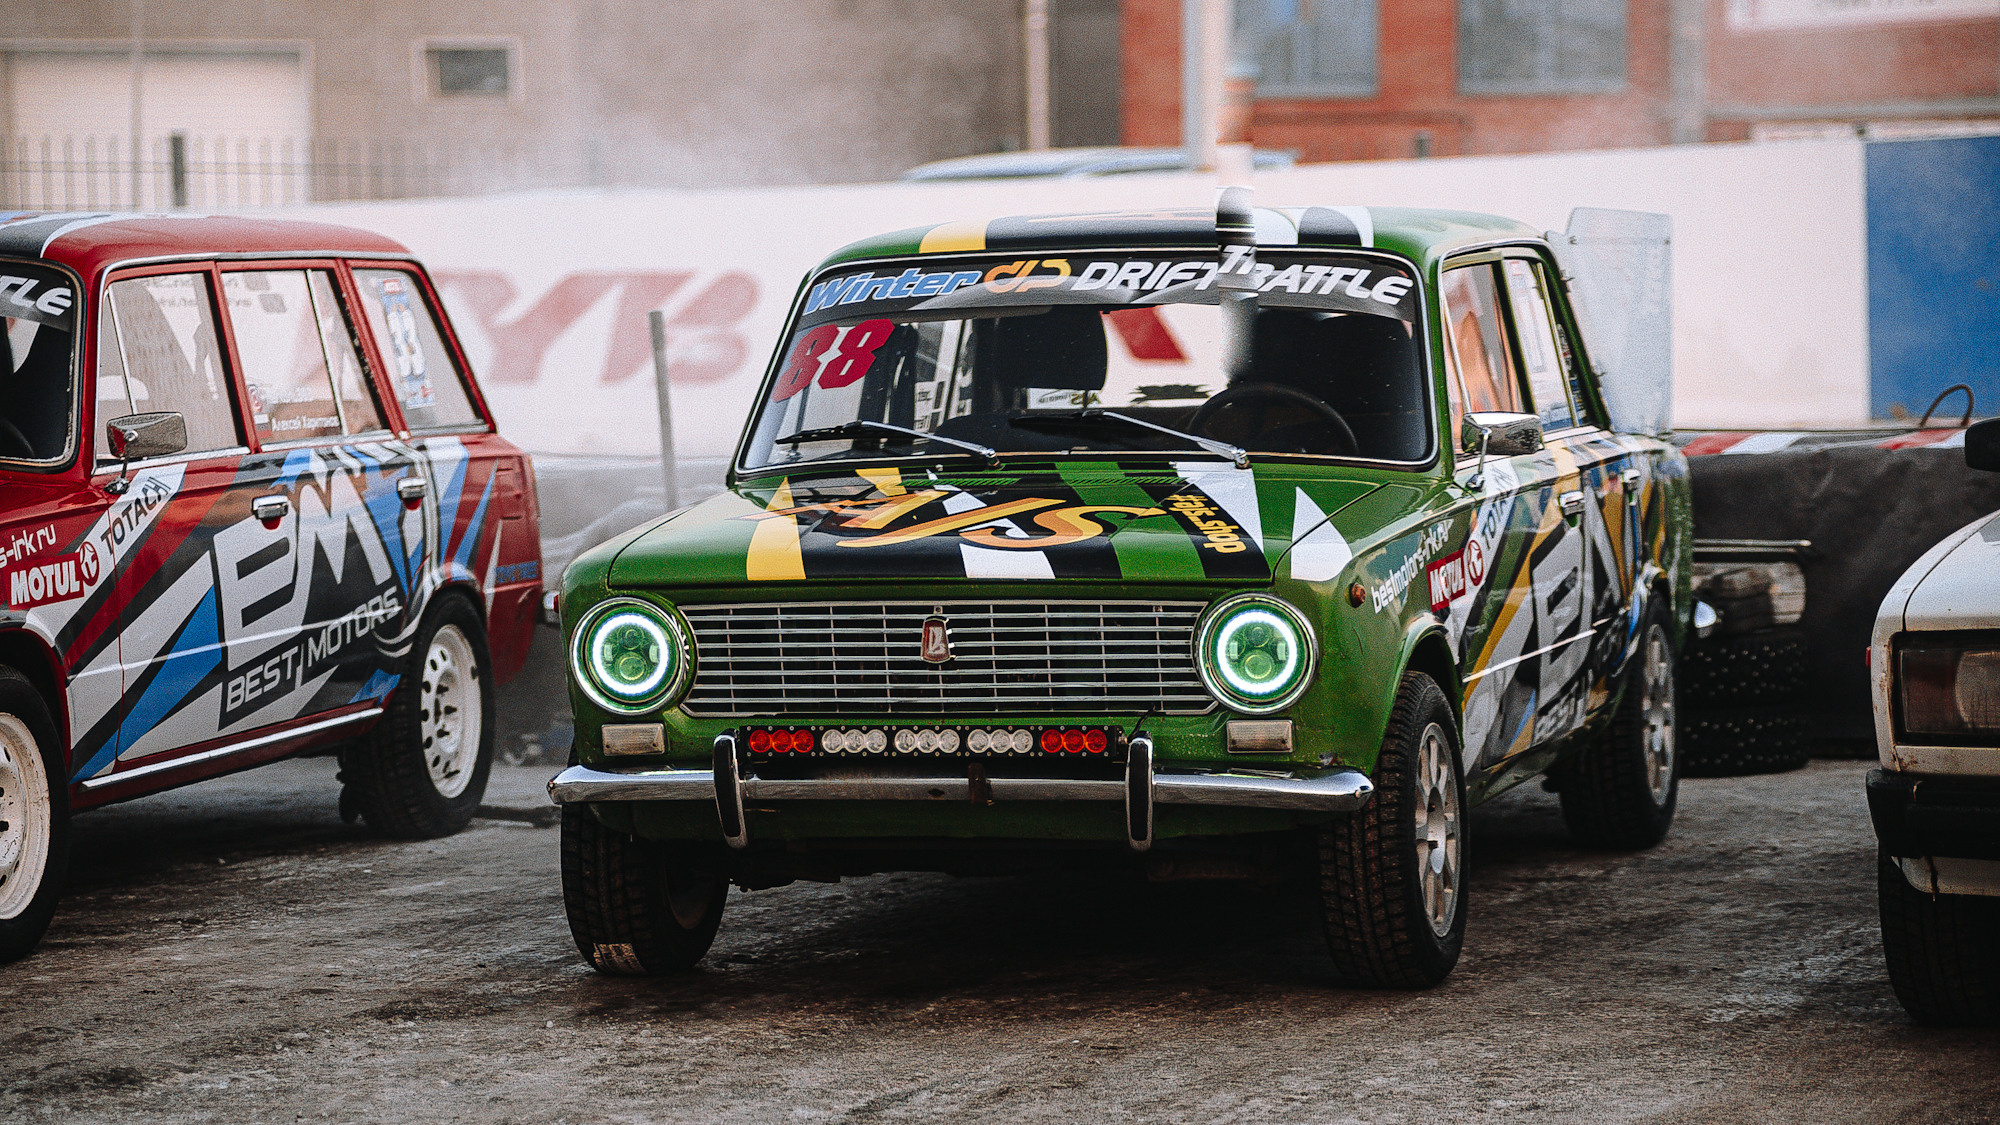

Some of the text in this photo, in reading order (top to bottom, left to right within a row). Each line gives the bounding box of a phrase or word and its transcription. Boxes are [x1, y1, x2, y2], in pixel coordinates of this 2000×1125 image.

[802, 268, 982, 316] Winter
[771, 318, 896, 403] 88
[100, 477, 171, 556] TOTACHI
[11, 560, 80, 606] MOTUL
[1429, 558, 1465, 606] MOTUL
[226, 586, 402, 712] BEST MOTORS
